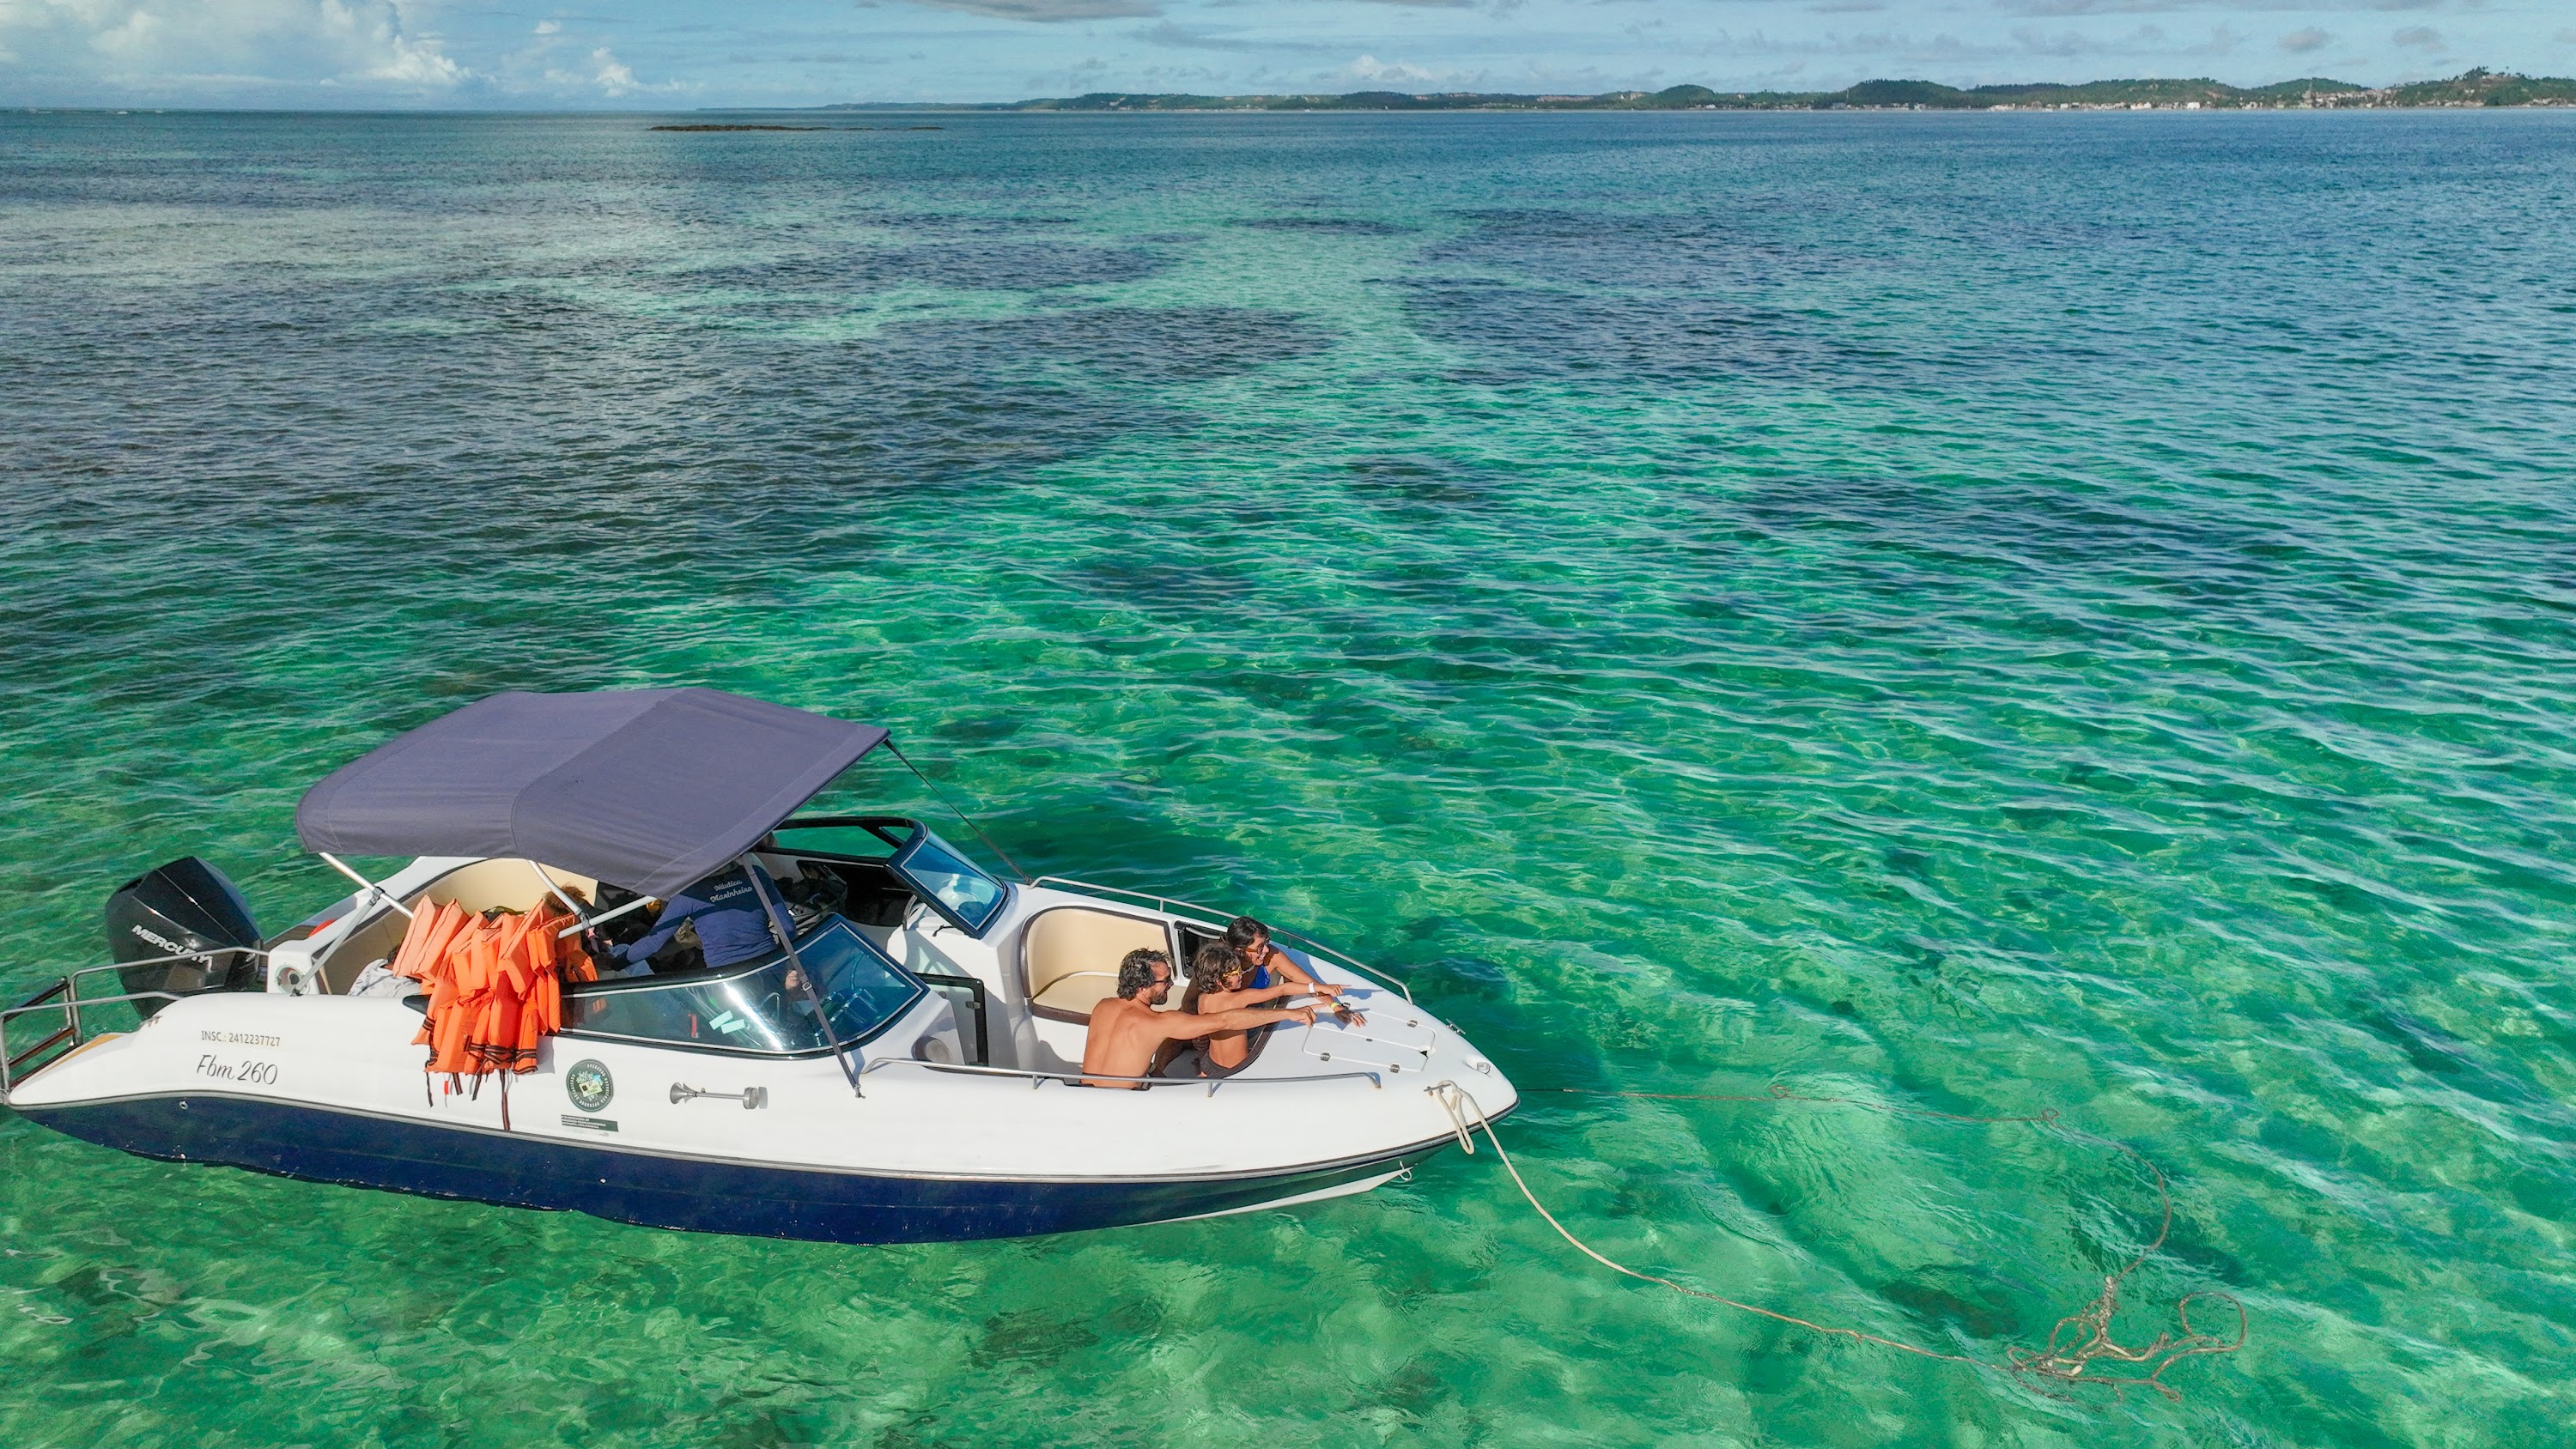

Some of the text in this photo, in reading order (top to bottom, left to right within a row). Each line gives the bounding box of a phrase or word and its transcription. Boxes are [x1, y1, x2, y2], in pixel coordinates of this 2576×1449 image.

[228, 1033, 280, 1046] 2412237727
[197, 1054, 278, 1085] Fbm 260
